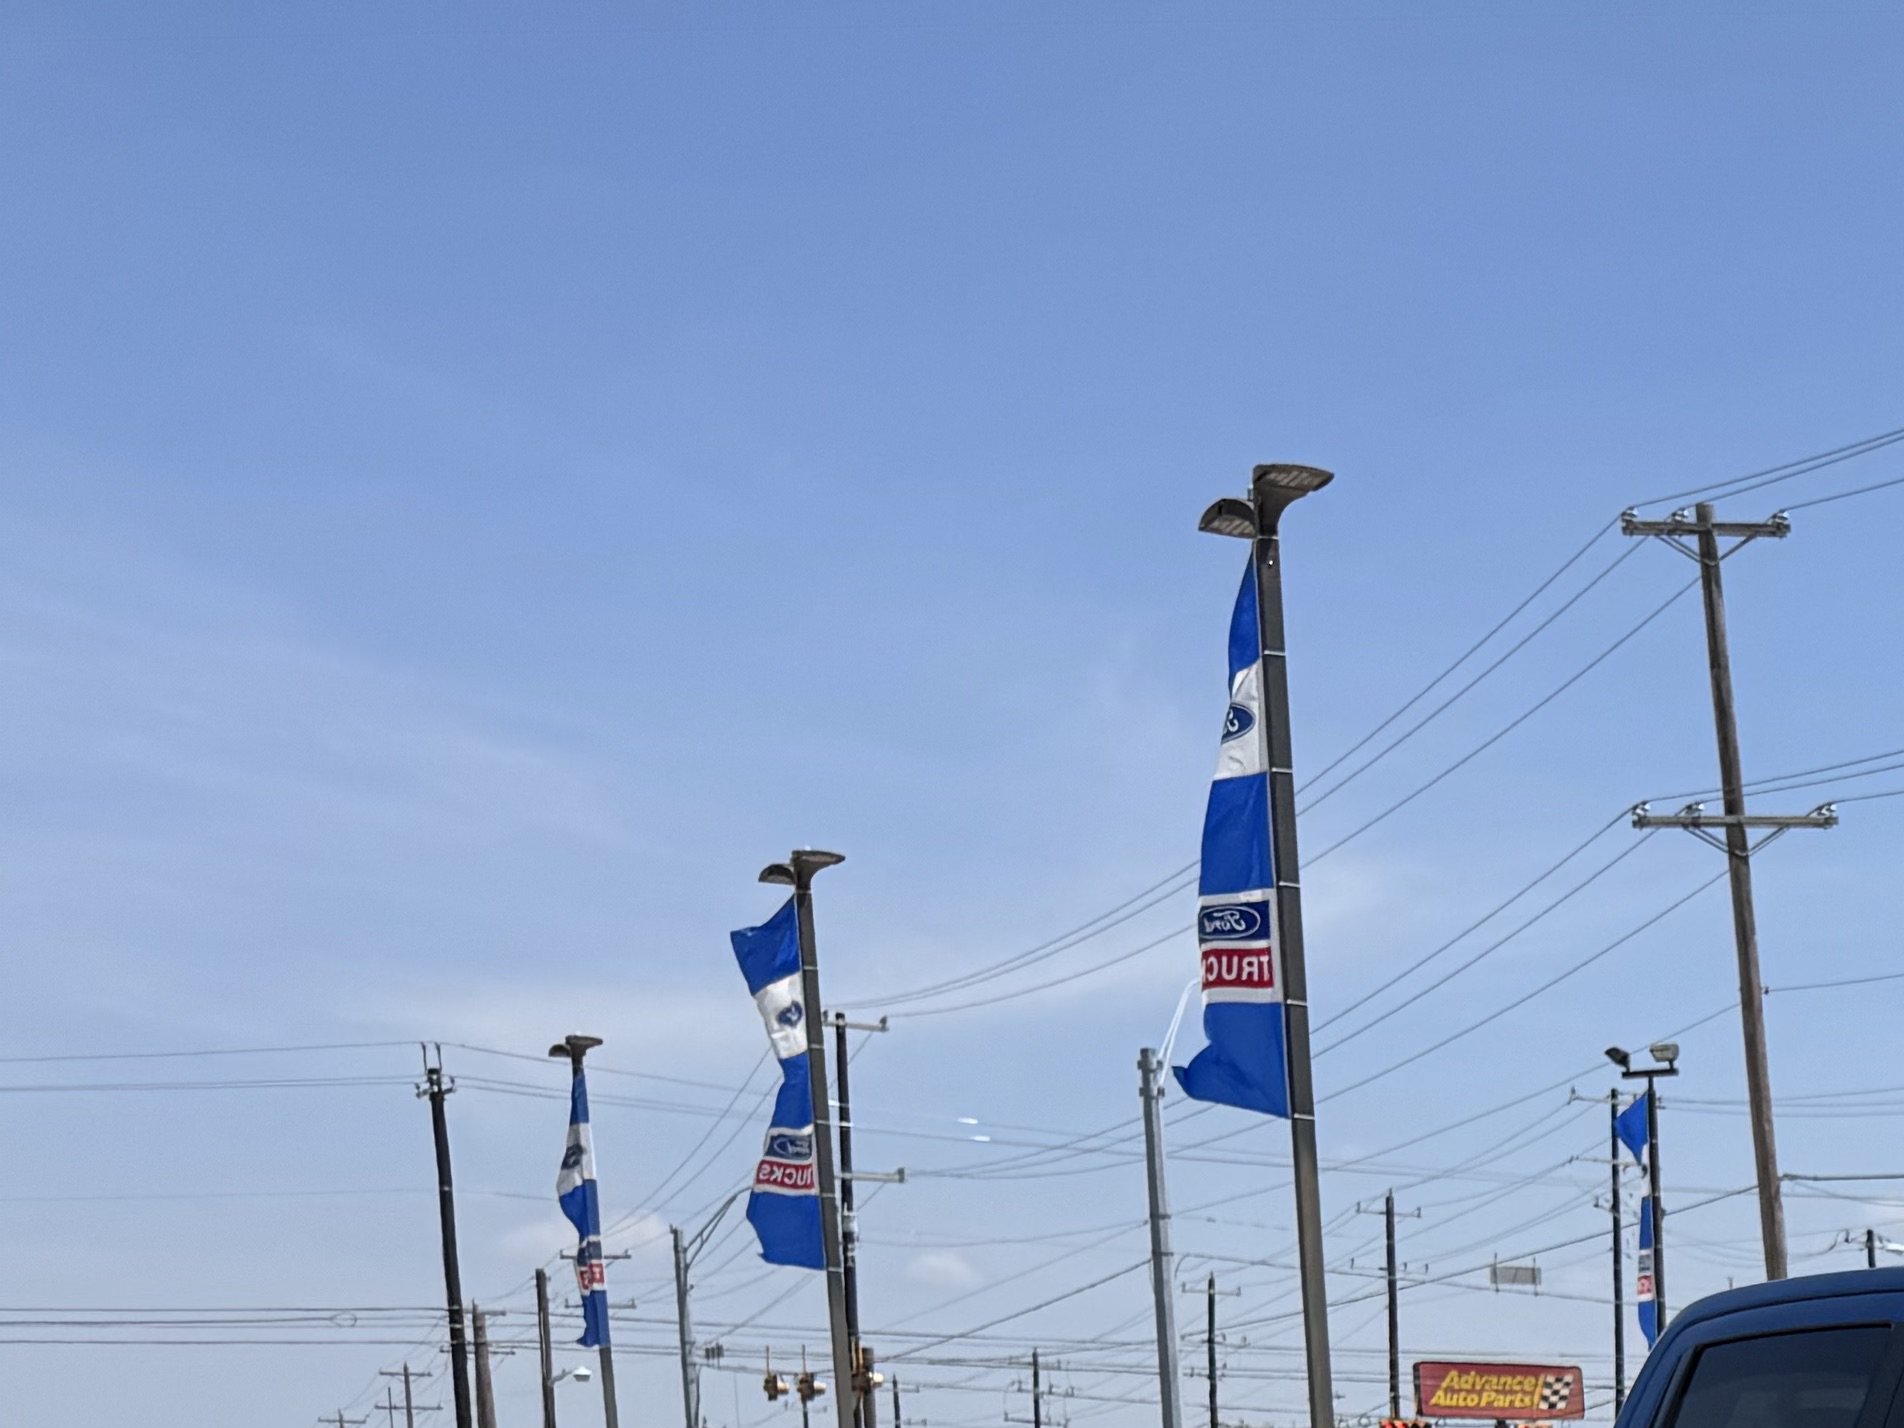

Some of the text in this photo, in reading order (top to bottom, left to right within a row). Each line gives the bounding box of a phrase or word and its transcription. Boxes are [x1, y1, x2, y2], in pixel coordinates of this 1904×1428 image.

[1439, 1369, 1537, 1392] Advance
[1429, 1390, 1533, 1409] Auto Parts
